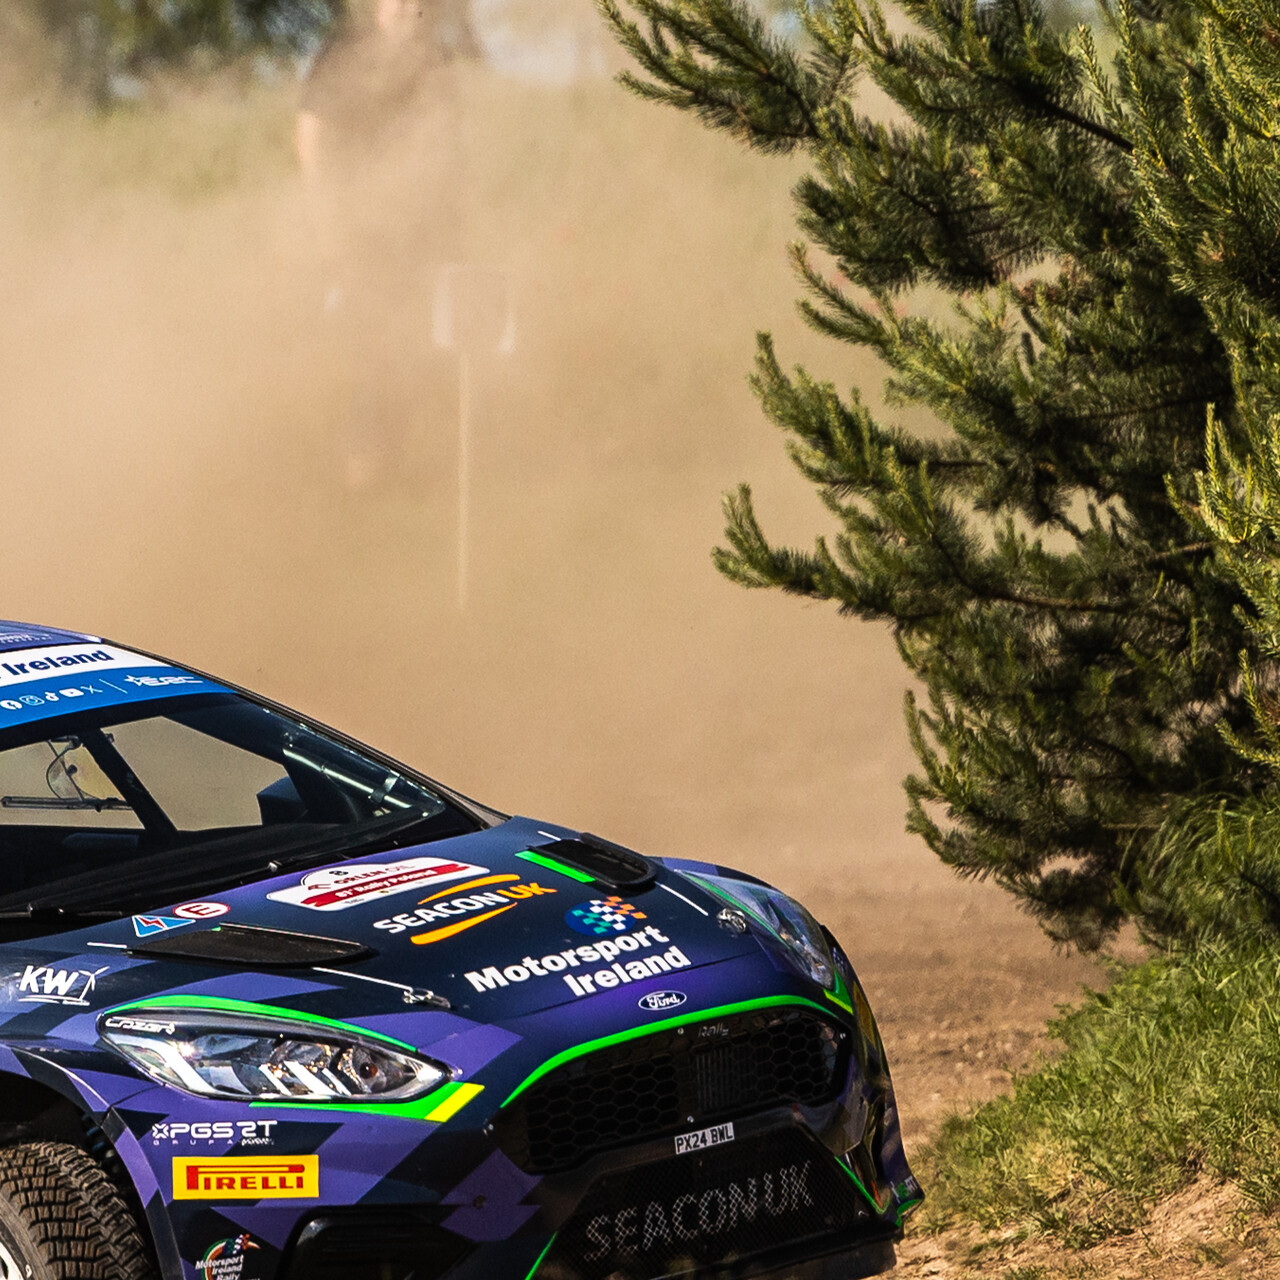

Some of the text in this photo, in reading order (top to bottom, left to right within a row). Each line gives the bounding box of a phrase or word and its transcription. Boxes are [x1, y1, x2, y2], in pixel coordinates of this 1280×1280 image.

[1, 649, 115, 682] Ireland
[357, 878, 391, 893] Rally
[388, 869, 438, 885] Poland
[372, 881, 559, 935] SEACON UK
[464, 924, 670, 993] Motorsport
[562, 946, 691, 997] Ireland
[19, 964, 80, 996] KW
[646, 992, 681, 1010] Ford
[169, 1122, 235, 1139] PGS
[676, 1132, 709, 1153] PX24
[186, 1163, 306, 1191] PIRELLI
[582, 1178, 758, 1262] SEACON
[763, 1159, 815, 1217] UK
[195, 1254, 245, 1271] Motorsport
[211, 1263, 243, 1276] Ireland
